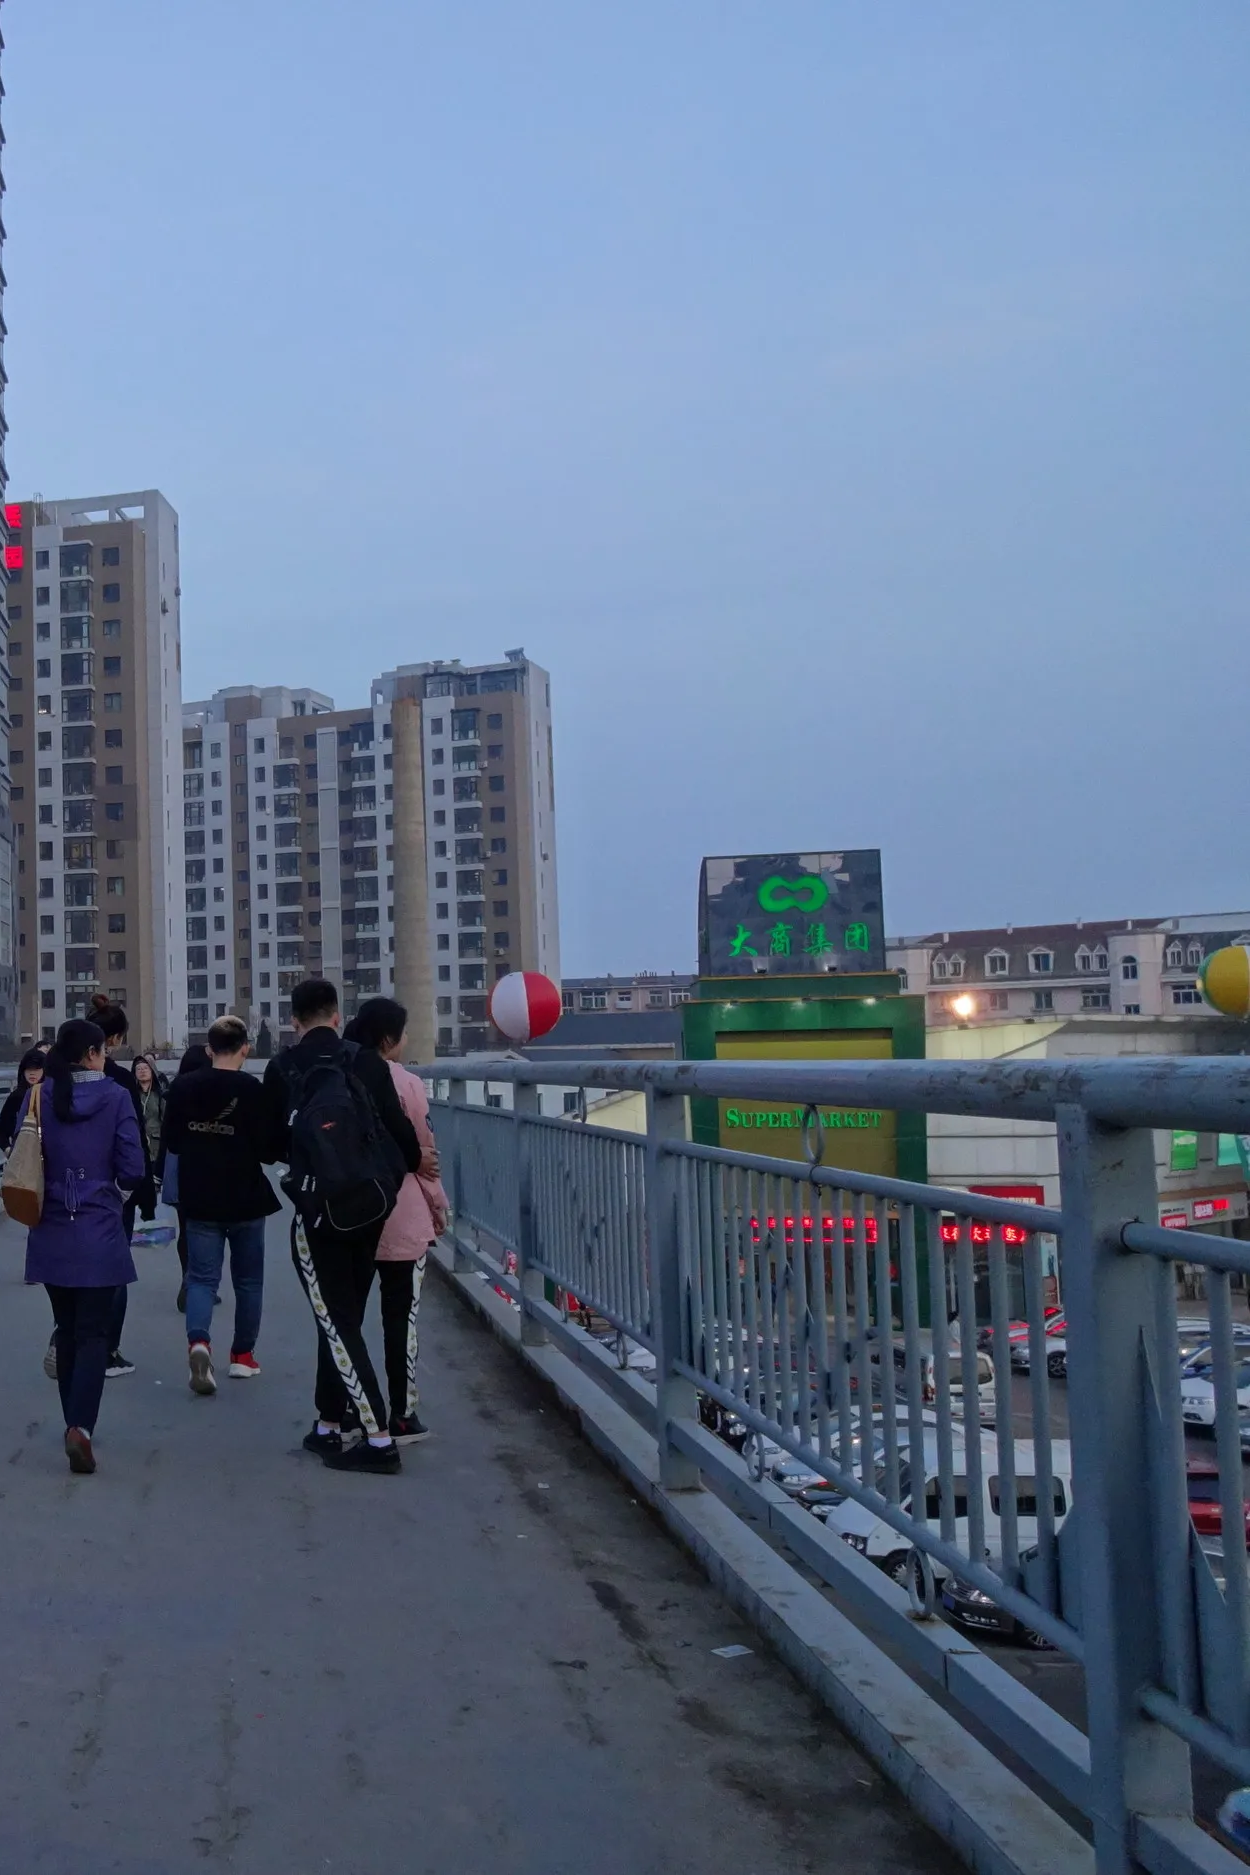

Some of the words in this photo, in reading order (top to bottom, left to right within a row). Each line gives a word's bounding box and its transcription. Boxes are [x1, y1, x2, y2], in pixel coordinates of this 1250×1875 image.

[729, 922, 870, 958] 大商集团
[188, 1121, 234, 1135] adidas
